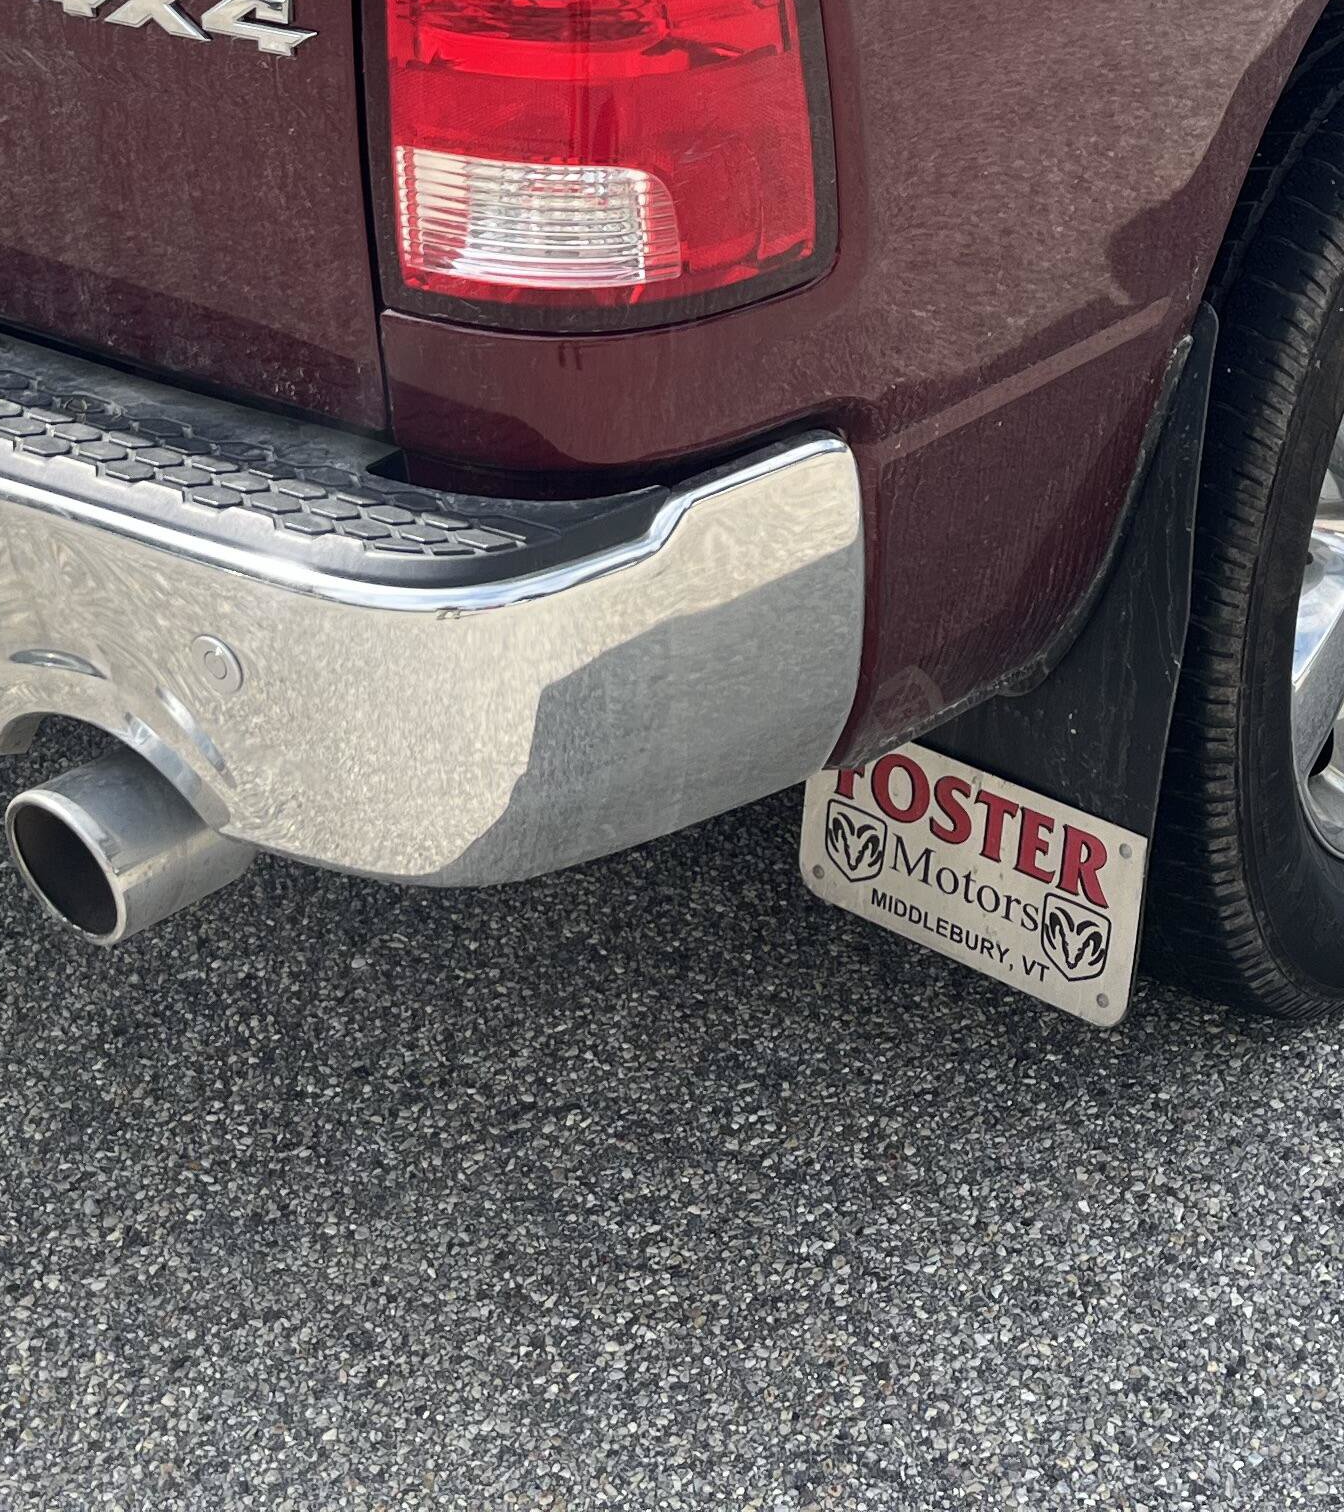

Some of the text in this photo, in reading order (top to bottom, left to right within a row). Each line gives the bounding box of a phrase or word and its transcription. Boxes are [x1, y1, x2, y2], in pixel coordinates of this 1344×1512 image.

[891, 833, 1040, 933] Motors
[870, 888, 1051, 983] MIDDLEBURY, VT
